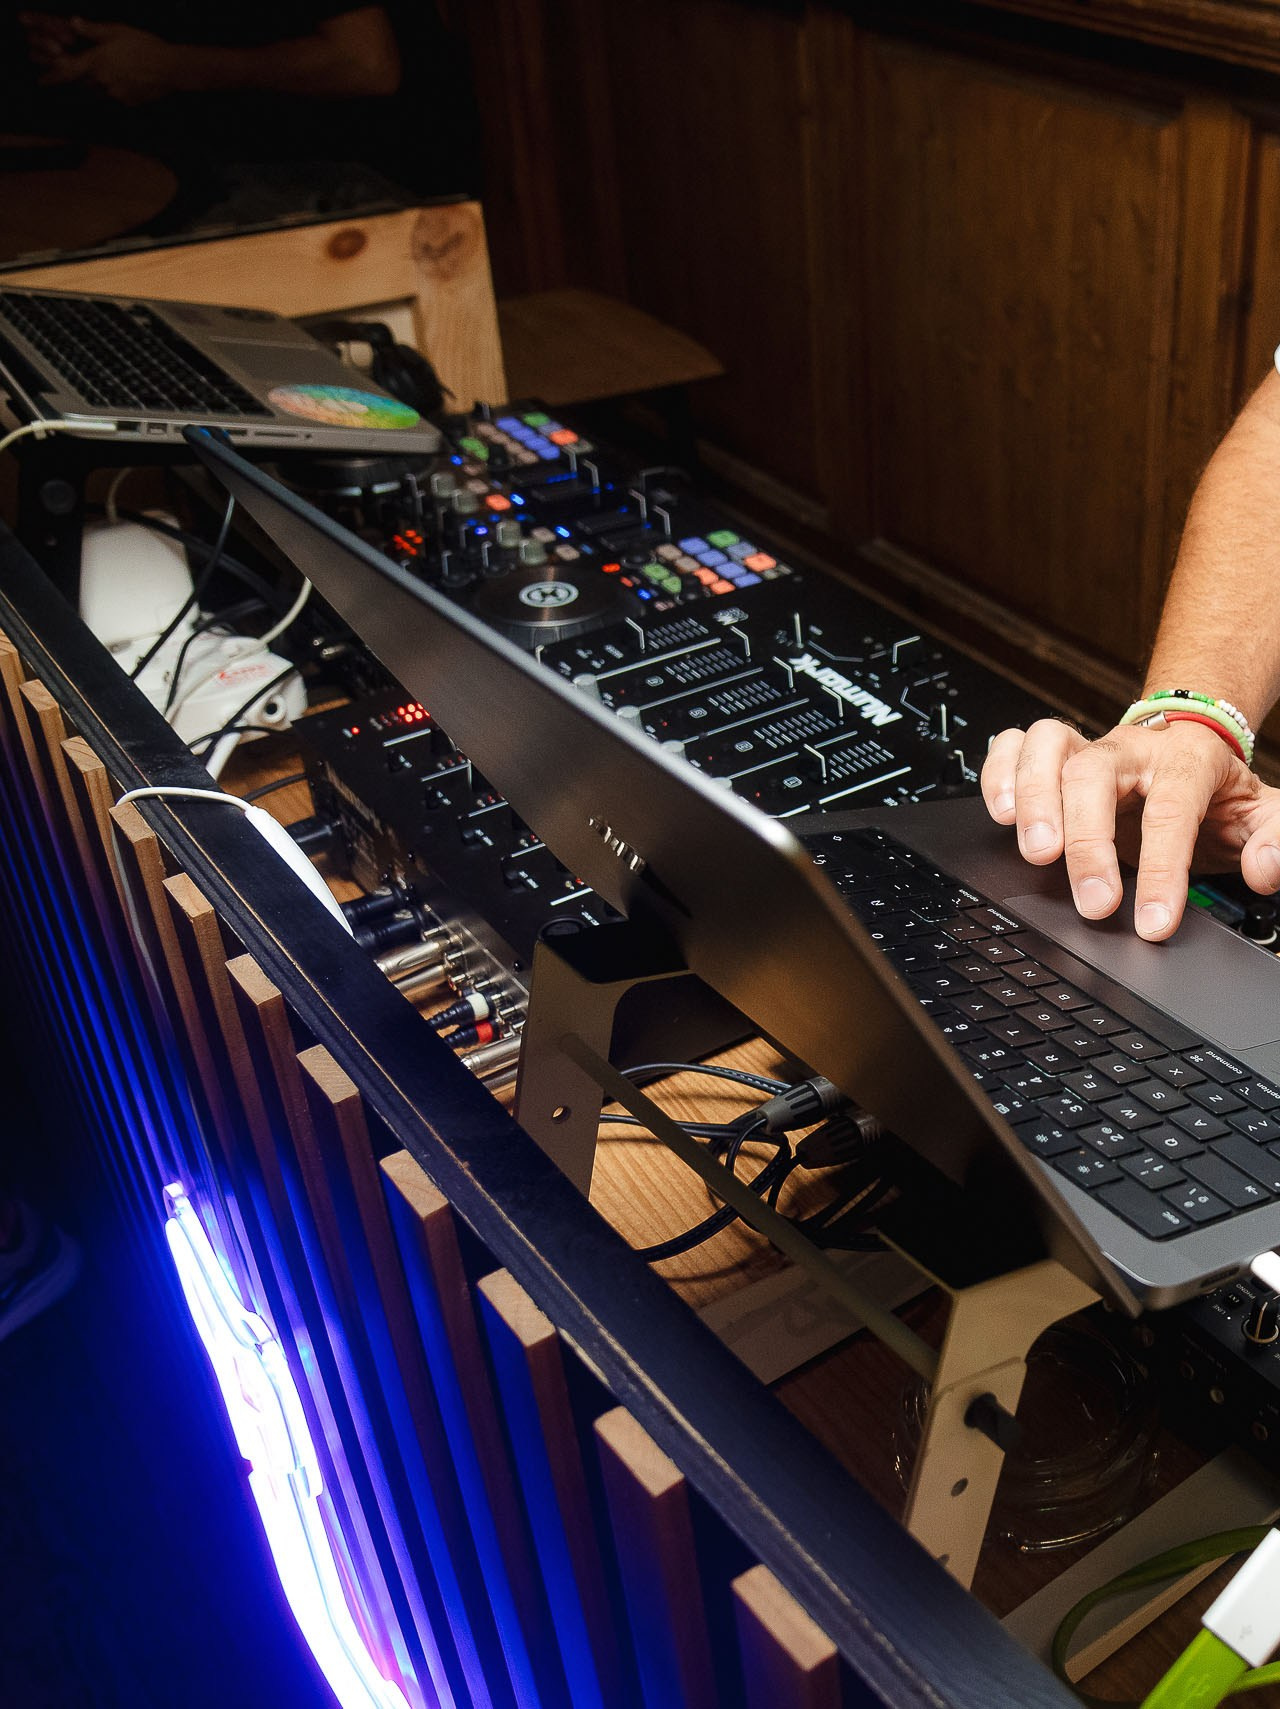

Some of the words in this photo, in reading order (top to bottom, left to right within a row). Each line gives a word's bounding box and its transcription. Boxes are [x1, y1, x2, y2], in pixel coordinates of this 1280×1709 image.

[789, 653, 903, 727] Numark
[959, 889, 980, 902] option
[987, 908, 1019, 928] command
[988, 947, 1003, 955] M
[1022, 970, 1037, 978] N
[1001, 989, 1016, 997] H
[1058, 993, 1071, 1001] B
[1037, 1013, 1051, 1021] G
[955, 1023, 969, 1031] 6
[1131, 1042, 1144, 1050] C
[991, 1049, 1006, 1057] 5
[1045, 1054, 1059, 1062] R
[1206, 1050, 1243, 1075] command
[1113, 1065, 1127, 1073] D
[1168, 1068, 1184, 1076] X
[1083, 1081, 1097, 1089] E
[1152, 1091, 1166, 1100] S
[1208, 1094, 1224, 1103] Z
[1069, 1104, 1083, 1113] 3
[1120, 1109, 1138, 1119] W
[1109, 1133, 1124, 1142] 2
[1164, 1137, 1179, 1147] Q
